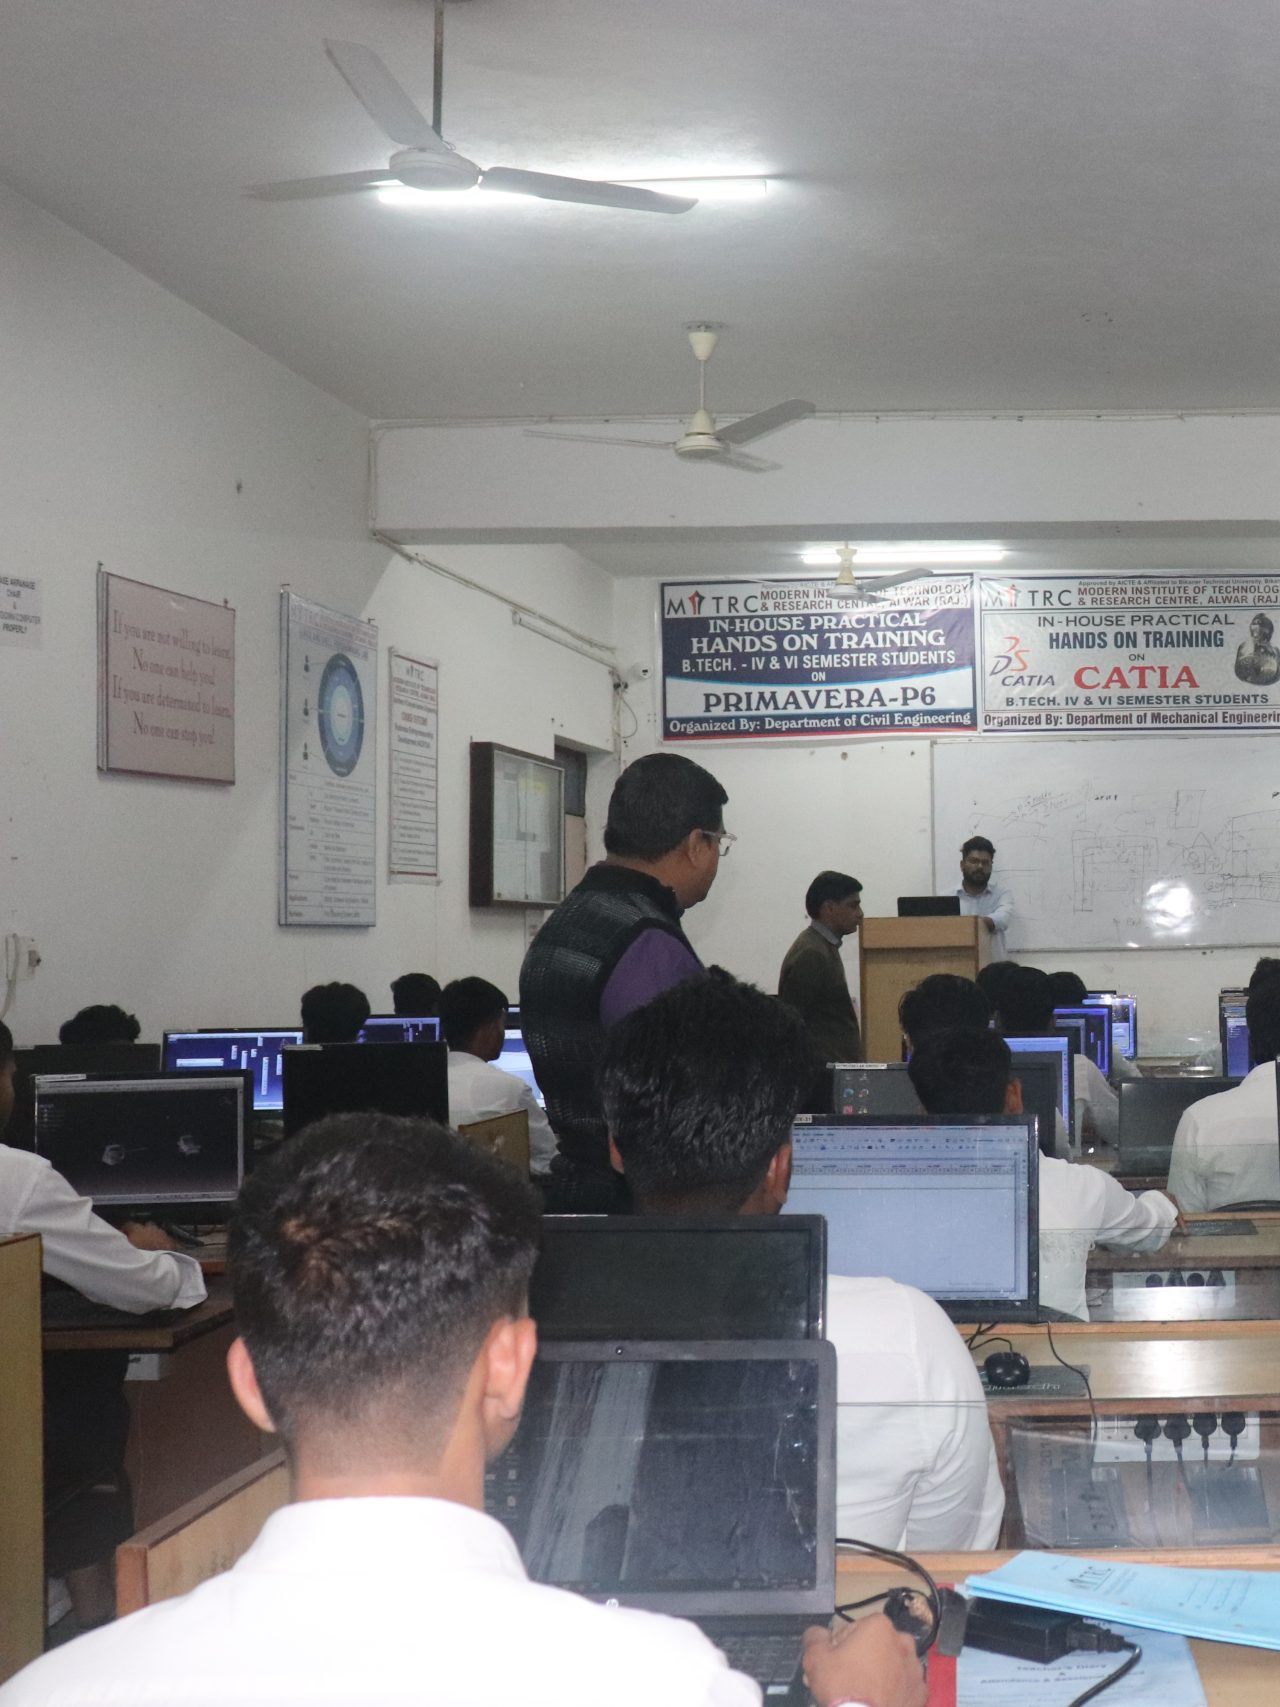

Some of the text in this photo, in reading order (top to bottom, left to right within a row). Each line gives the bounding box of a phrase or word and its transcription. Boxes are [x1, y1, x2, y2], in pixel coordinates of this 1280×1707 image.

[760, 589, 810, 601] MODERN
[1078, 586, 1128, 596] MODERN
[1131, 585, 1188, 596] INSTITUTE
[1192, 585, 1207, 595] OF
[760, 602, 769, 611] &
[773, 600, 833, 611] RESEARCH
[1077, 597, 1086, 606] &
[1090, 596, 1150, 606] RESEARCH
[1155, 595, 1203, 606] CENTRE,
[1207, 595, 1249, 605] ALWAR
[708, 612, 928, 633] IN-HOUSE PRACTICAL
[1130, 613, 1235, 627] PRACTICAL
[113, 609, 123, 633] If
[124, 623, 140, 641] you
[142, 629, 155, 642] are
[157, 632, 171, 646] not
[172, 628, 201, 656] willing
[202, 641, 210, 654] to
[1049, 630, 1224, 650] HANDS ON TRAINING
[690, 628, 946, 655] HANDS ON TRAINING
[132, 646, 148, 673] No
[149, 662, 164, 676] one
[165, 665, 179, 678] can
[181, 657, 198, 686] help
[682, 658, 737, 673] B.TECH.
[751, 656, 766, 670] IV
[769, 656, 781, 670] &
[784, 655, 798, 669] VI
[802, 653, 878, 669] SEMESTER
[881, 650, 956, 666] STUDENTS
[1128, 653, 1145, 662] ON
[811, 671, 826, 682] ON
[1001, 674, 1056, 687] CATIA
[1073, 665, 1200, 690] CATIA
[113, 674, 123, 699] If
[123, 687, 140, 705] you
[141, 692, 155, 705] are
[157, 684, 201, 713] determined
[202, 702, 210, 714] to
[703, 686, 936, 713] PRIMAVERA-P6
[1005, 693, 1269, 707] B.TECH. IV & VI SEMESTER STUDENTS
[669, 711, 972, 734] Organized By: Department of Civil Engineering
[984, 713, 1042, 728] Organized
[1045, 713, 1063, 727] By:
[1066, 712, 1134, 727] Department
[1136, 712, 1148, 725] of
[1151, 711, 1218, 725] Mechanical
[132, 710, 148, 735] No
[150, 725, 164, 738] one
[166, 728, 179, 740] can
[181, 728, 198, 747] stop
[1016, 1663, 1107, 1672] Teacher's Diary
[980, 1677, 1041, 1685] Attendance
